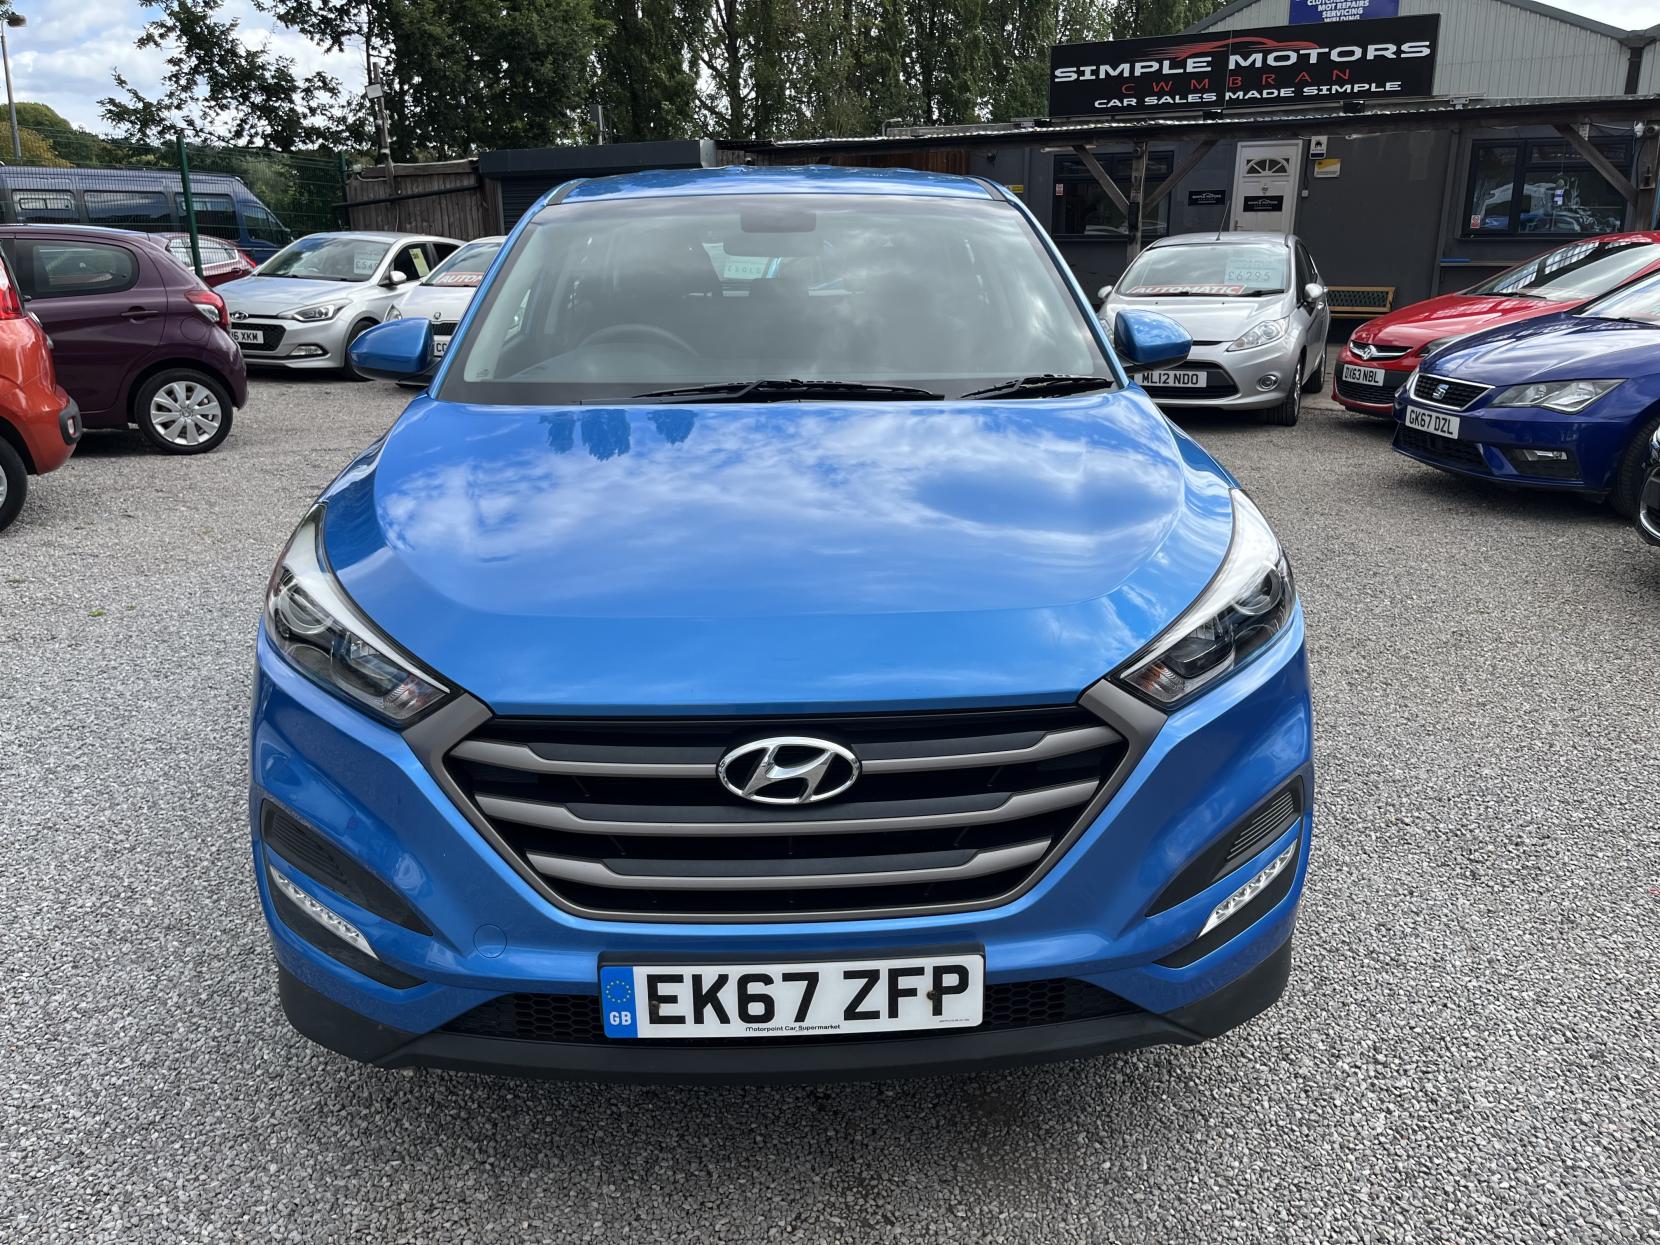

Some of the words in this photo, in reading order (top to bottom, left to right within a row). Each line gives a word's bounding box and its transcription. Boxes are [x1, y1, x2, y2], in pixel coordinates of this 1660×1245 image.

[1337, 0, 1369, 9] REPAIRS
[1322, 8, 1363, 18] SERVICING
[1054, 57, 1212, 82] SIMPLE
[1228, 41, 1431, 70] MOTORS
[1094, 98, 1137, 108] CAR
[1144, 93, 1217, 105] SALES
[1225, 88, 1295, 100] MADE
[1303, 82, 1402, 96] SIMPLE
[1132, 286, 1240, 294] AUTOMATIC
[241, 331, 259, 342] XKM
[1142, 372, 1170, 385] ML12
[1362, 369, 1379, 384] NBL
[1409, 410, 1433, 430] GK67
[1433, 415, 1453, 435] DZL
[646, 971, 820, 1025] EK67
[843, 964, 970, 1021] ZFP
[609, 1011, 631, 1026] GB
